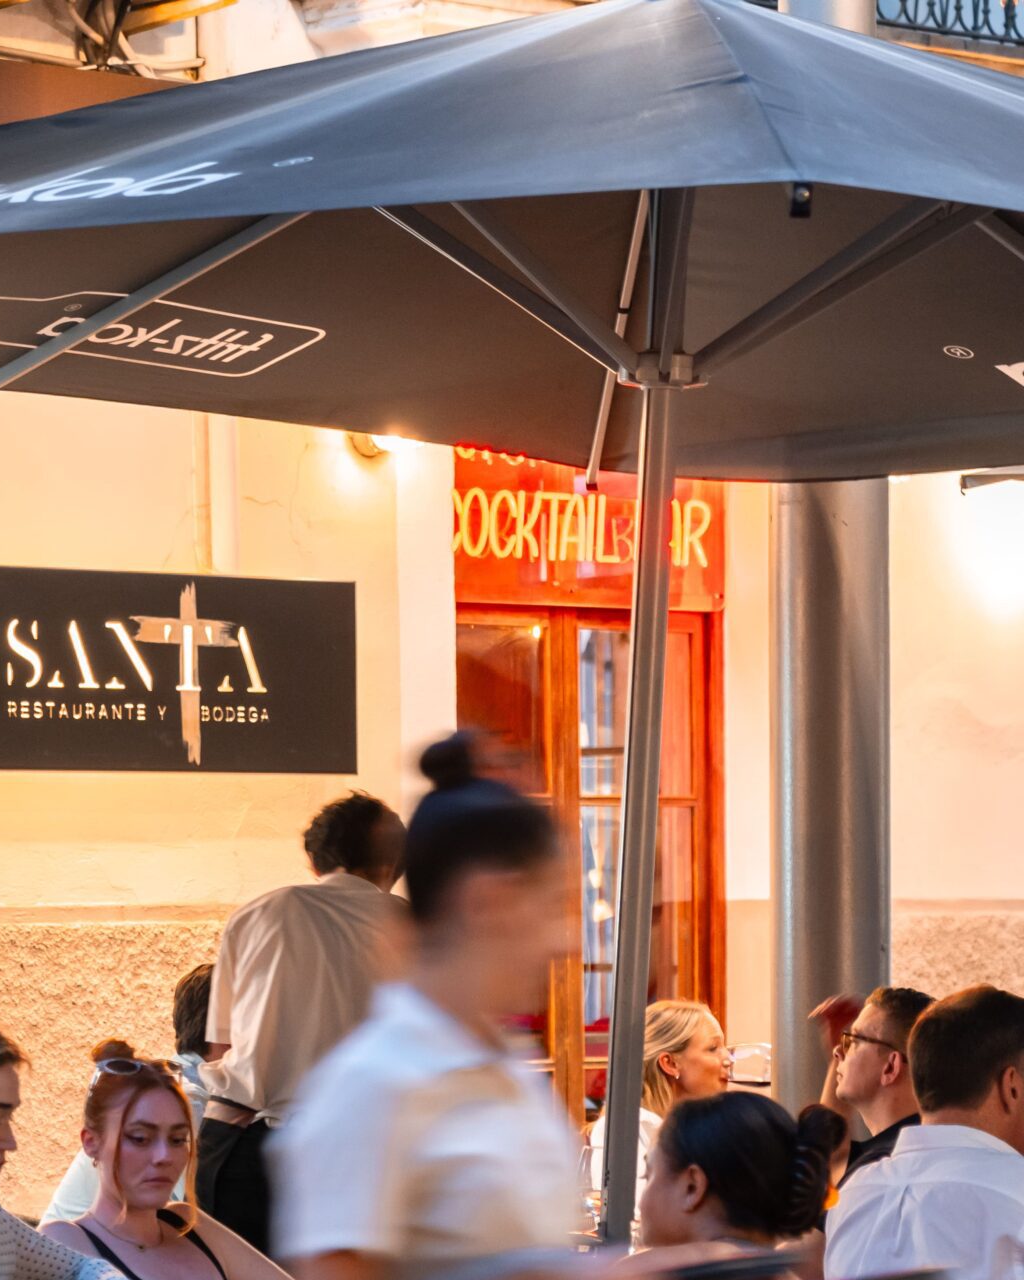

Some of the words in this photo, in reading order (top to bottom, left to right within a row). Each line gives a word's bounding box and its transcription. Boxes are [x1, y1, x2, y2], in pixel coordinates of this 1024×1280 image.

[6, 618, 268, 693] SANTA
[7, 701, 147, 721] RESTAURANTE
[157, 705, 168, 721] Y
[200, 705, 270, 723] BODEGA
